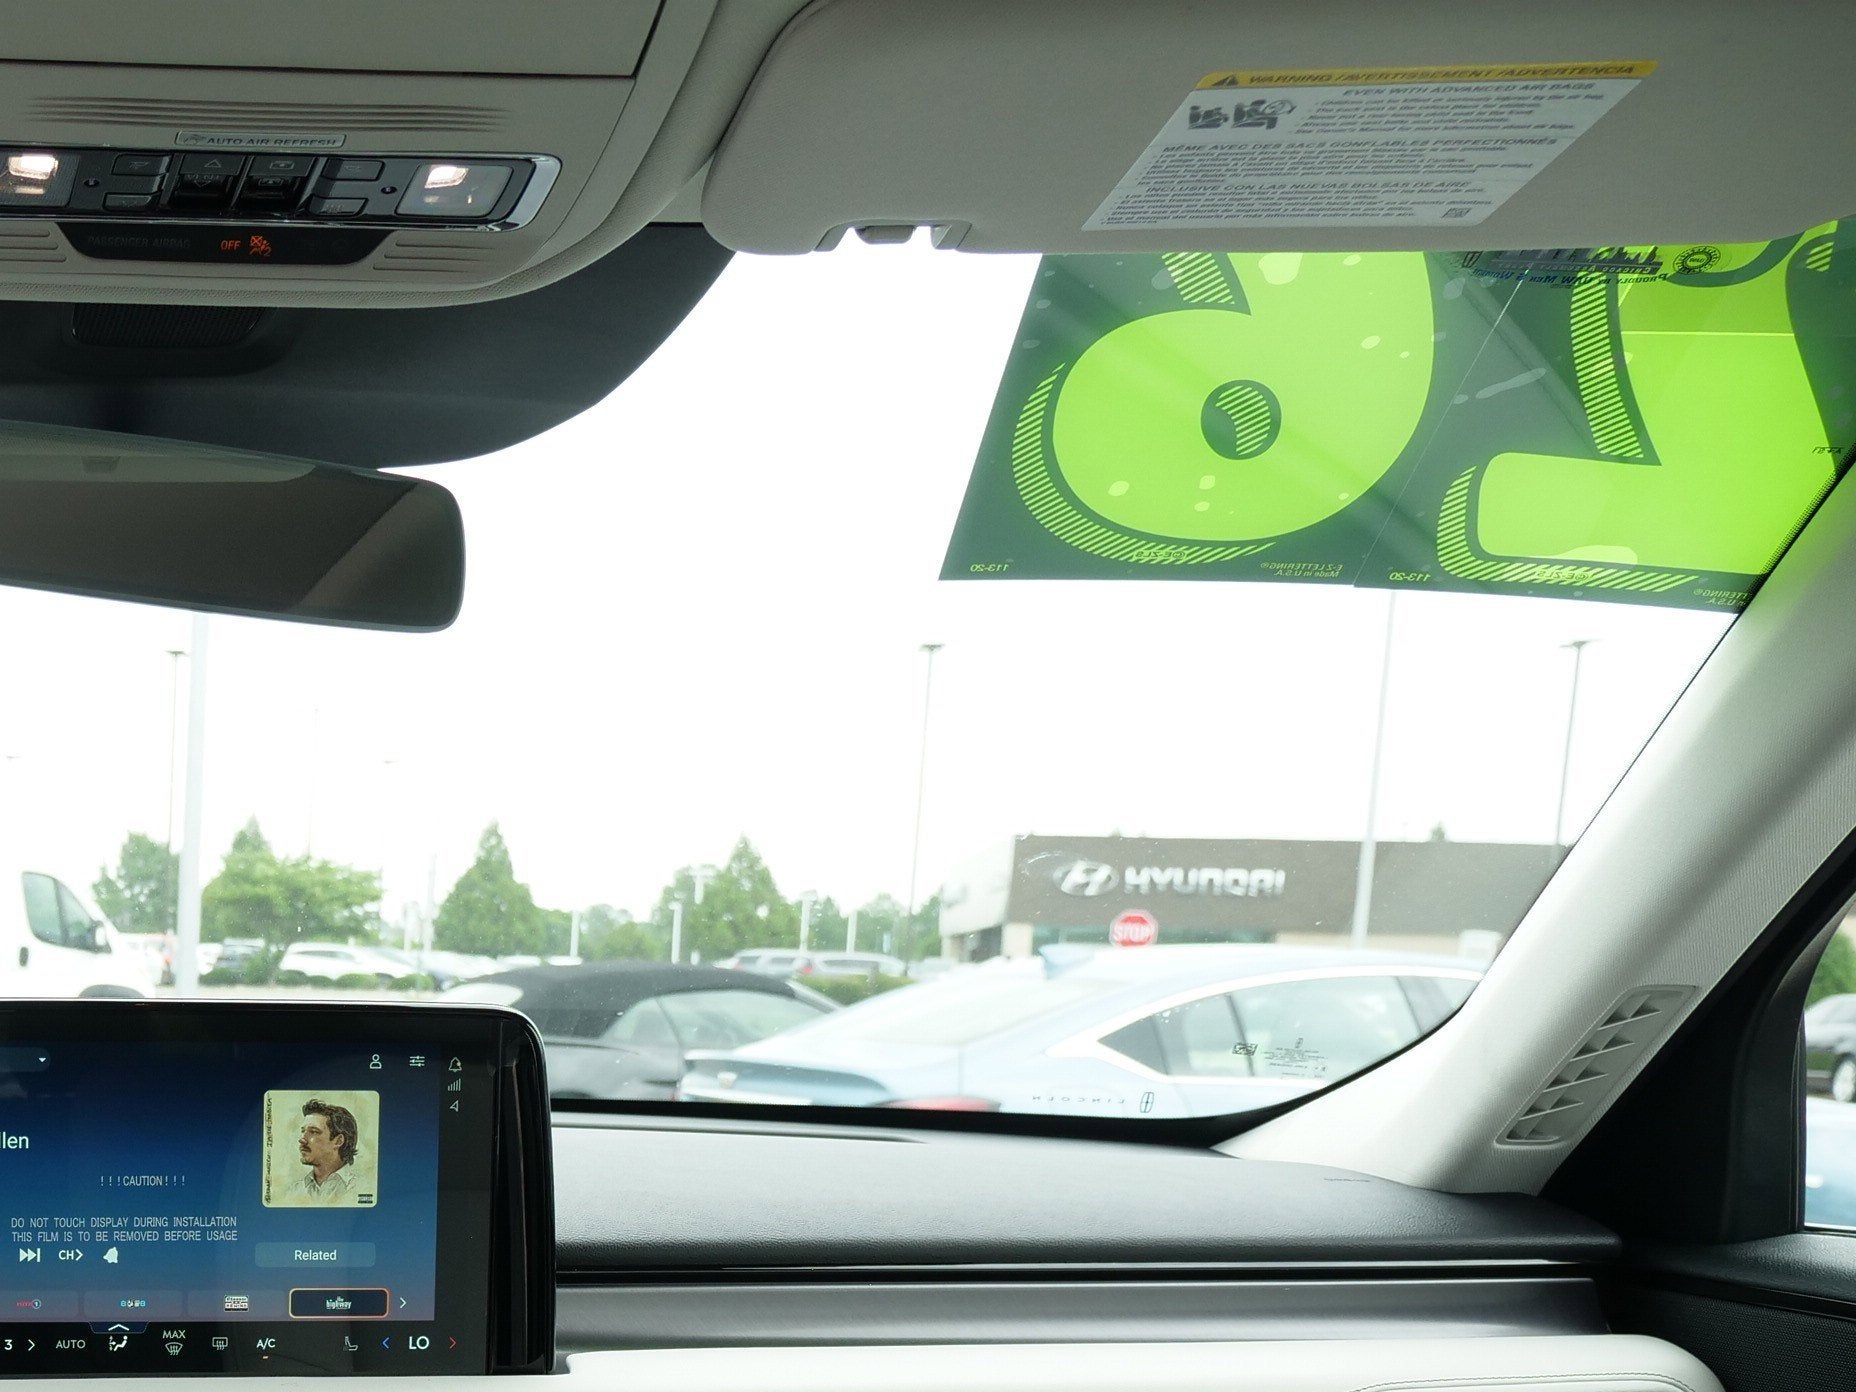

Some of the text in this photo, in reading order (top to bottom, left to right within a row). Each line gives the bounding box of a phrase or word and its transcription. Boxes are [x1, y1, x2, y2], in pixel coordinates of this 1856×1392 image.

[1246, 73, 1336, 83] WARNING
[1428, 85, 1517, 93] ADVANCED
[1545, 82, 1596, 90] BAGS
[207, 138, 242, 146] AUTO
[246, 138, 269, 146] AIR
[87, 237, 241, 250] PASSENGER AIRBAG OFF
[1124, 866, 1286, 897] HYUNDAI
[1113, 922, 1153, 941] STOP
[11, 1216, 237, 1228] DO NOT TOUCH DISPLAY DURING INSTALLATION
[12, 1230, 238, 1242] THIS FILM IS TO BE REMOVED BEFORE USAGE
[294, 1250, 337, 1261] Related
[162, 1330, 186, 1340] MAX
[4, 1340, 13, 1351] 3
[56, 1340, 86, 1349] AUTO
[256, 1338, 276, 1350] A/C
[408, 1336, 430, 1350] LO
